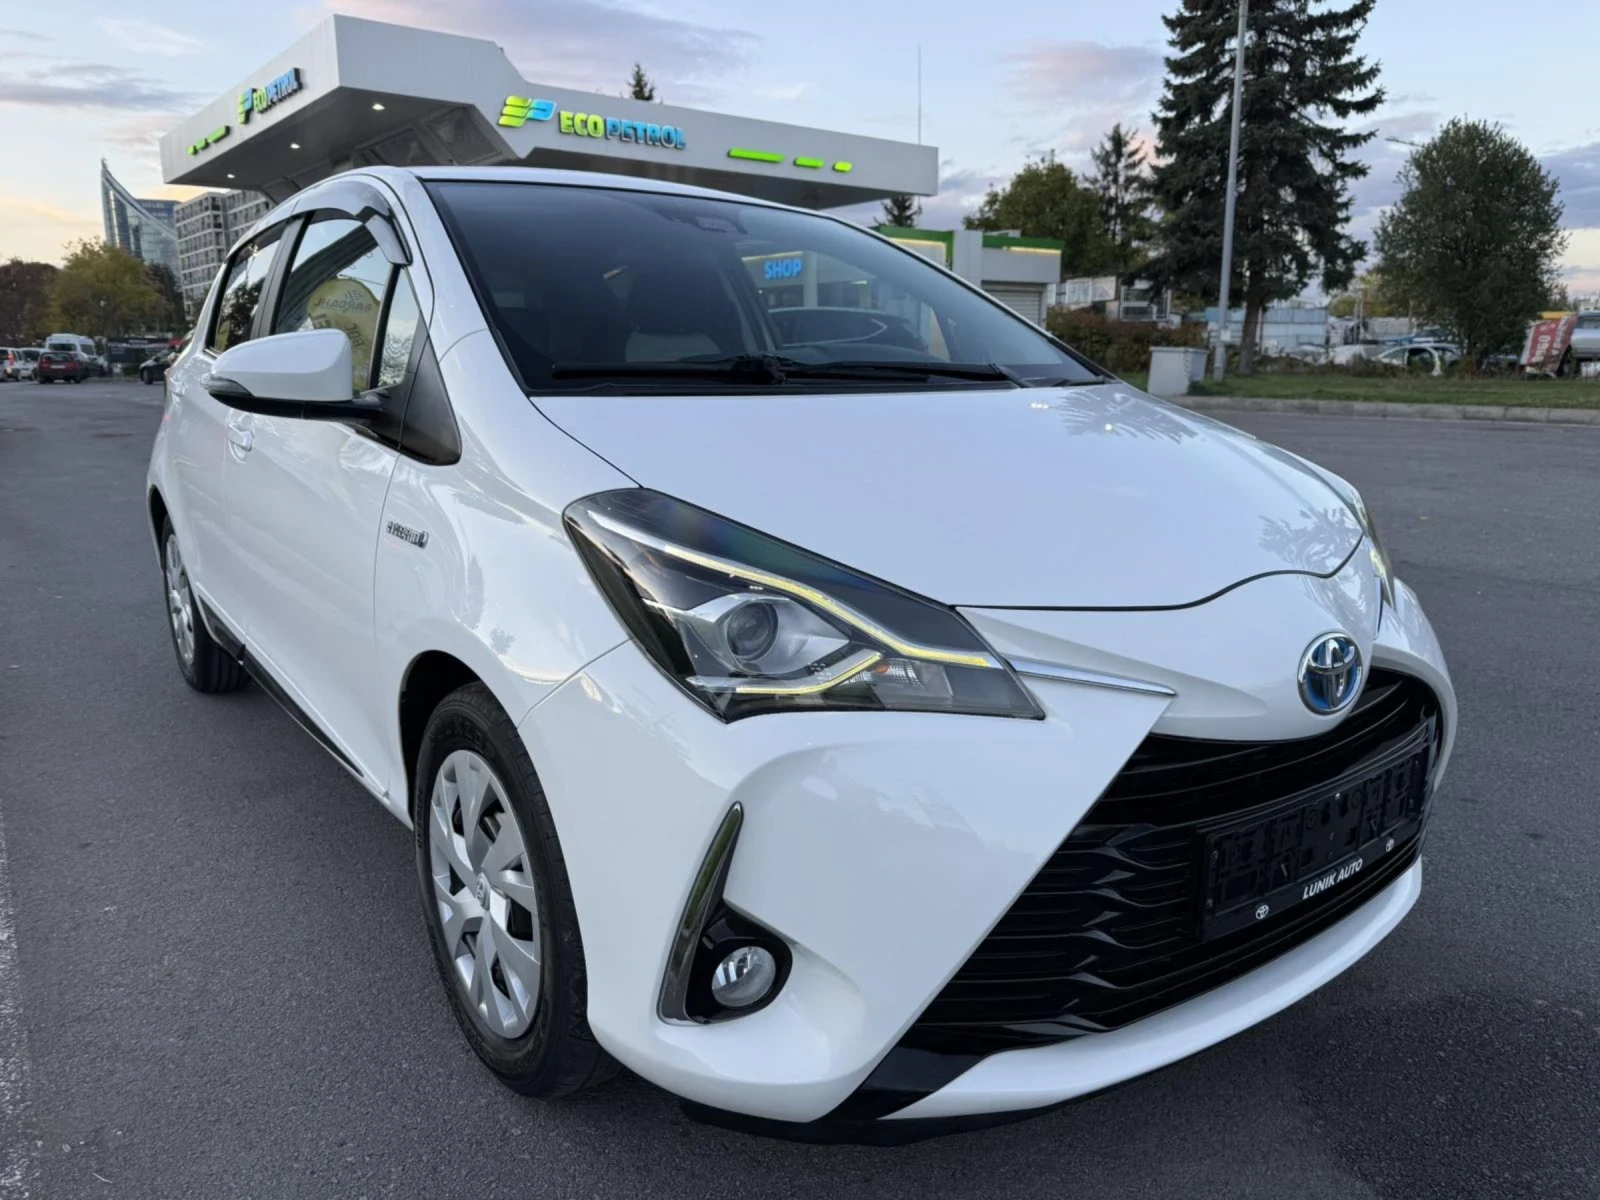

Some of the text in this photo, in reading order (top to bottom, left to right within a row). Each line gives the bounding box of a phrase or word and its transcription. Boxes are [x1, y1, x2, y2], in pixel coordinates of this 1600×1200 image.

[559, 110, 687, 149] ECOPETROL
[764, 258, 803, 279] SHOP
[1302, 858, 1363, 900] LUNIK AUTO
